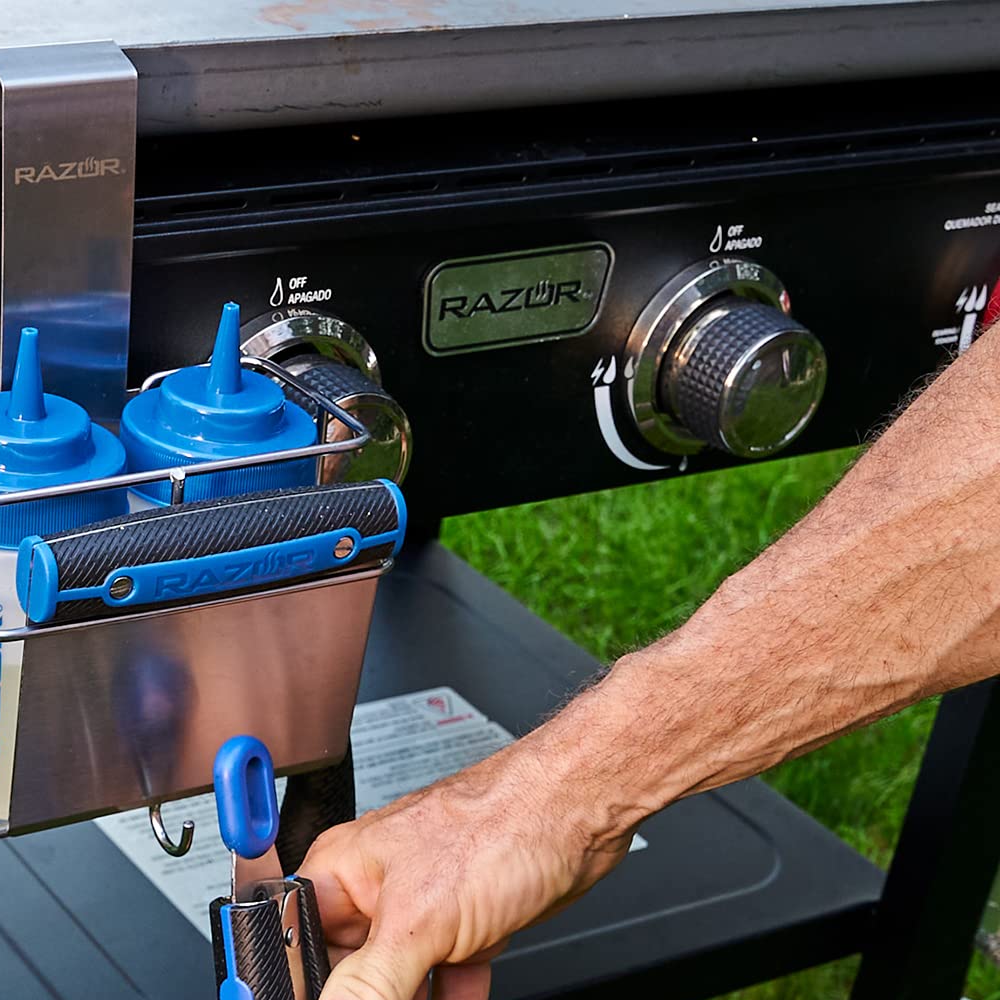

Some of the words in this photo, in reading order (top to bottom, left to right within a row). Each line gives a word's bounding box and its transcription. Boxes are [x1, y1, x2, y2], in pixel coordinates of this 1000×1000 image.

[14, 157, 121, 185] RAZOR
[727, 225, 744, 237] OFF
[724, 236, 762, 251] APAGADO
[289, 277, 308, 290] OFF
[288, 289, 332, 304] APAGADO
[438, 279, 582, 321] RAZOR
[154, 549, 316, 598] RAZOR
